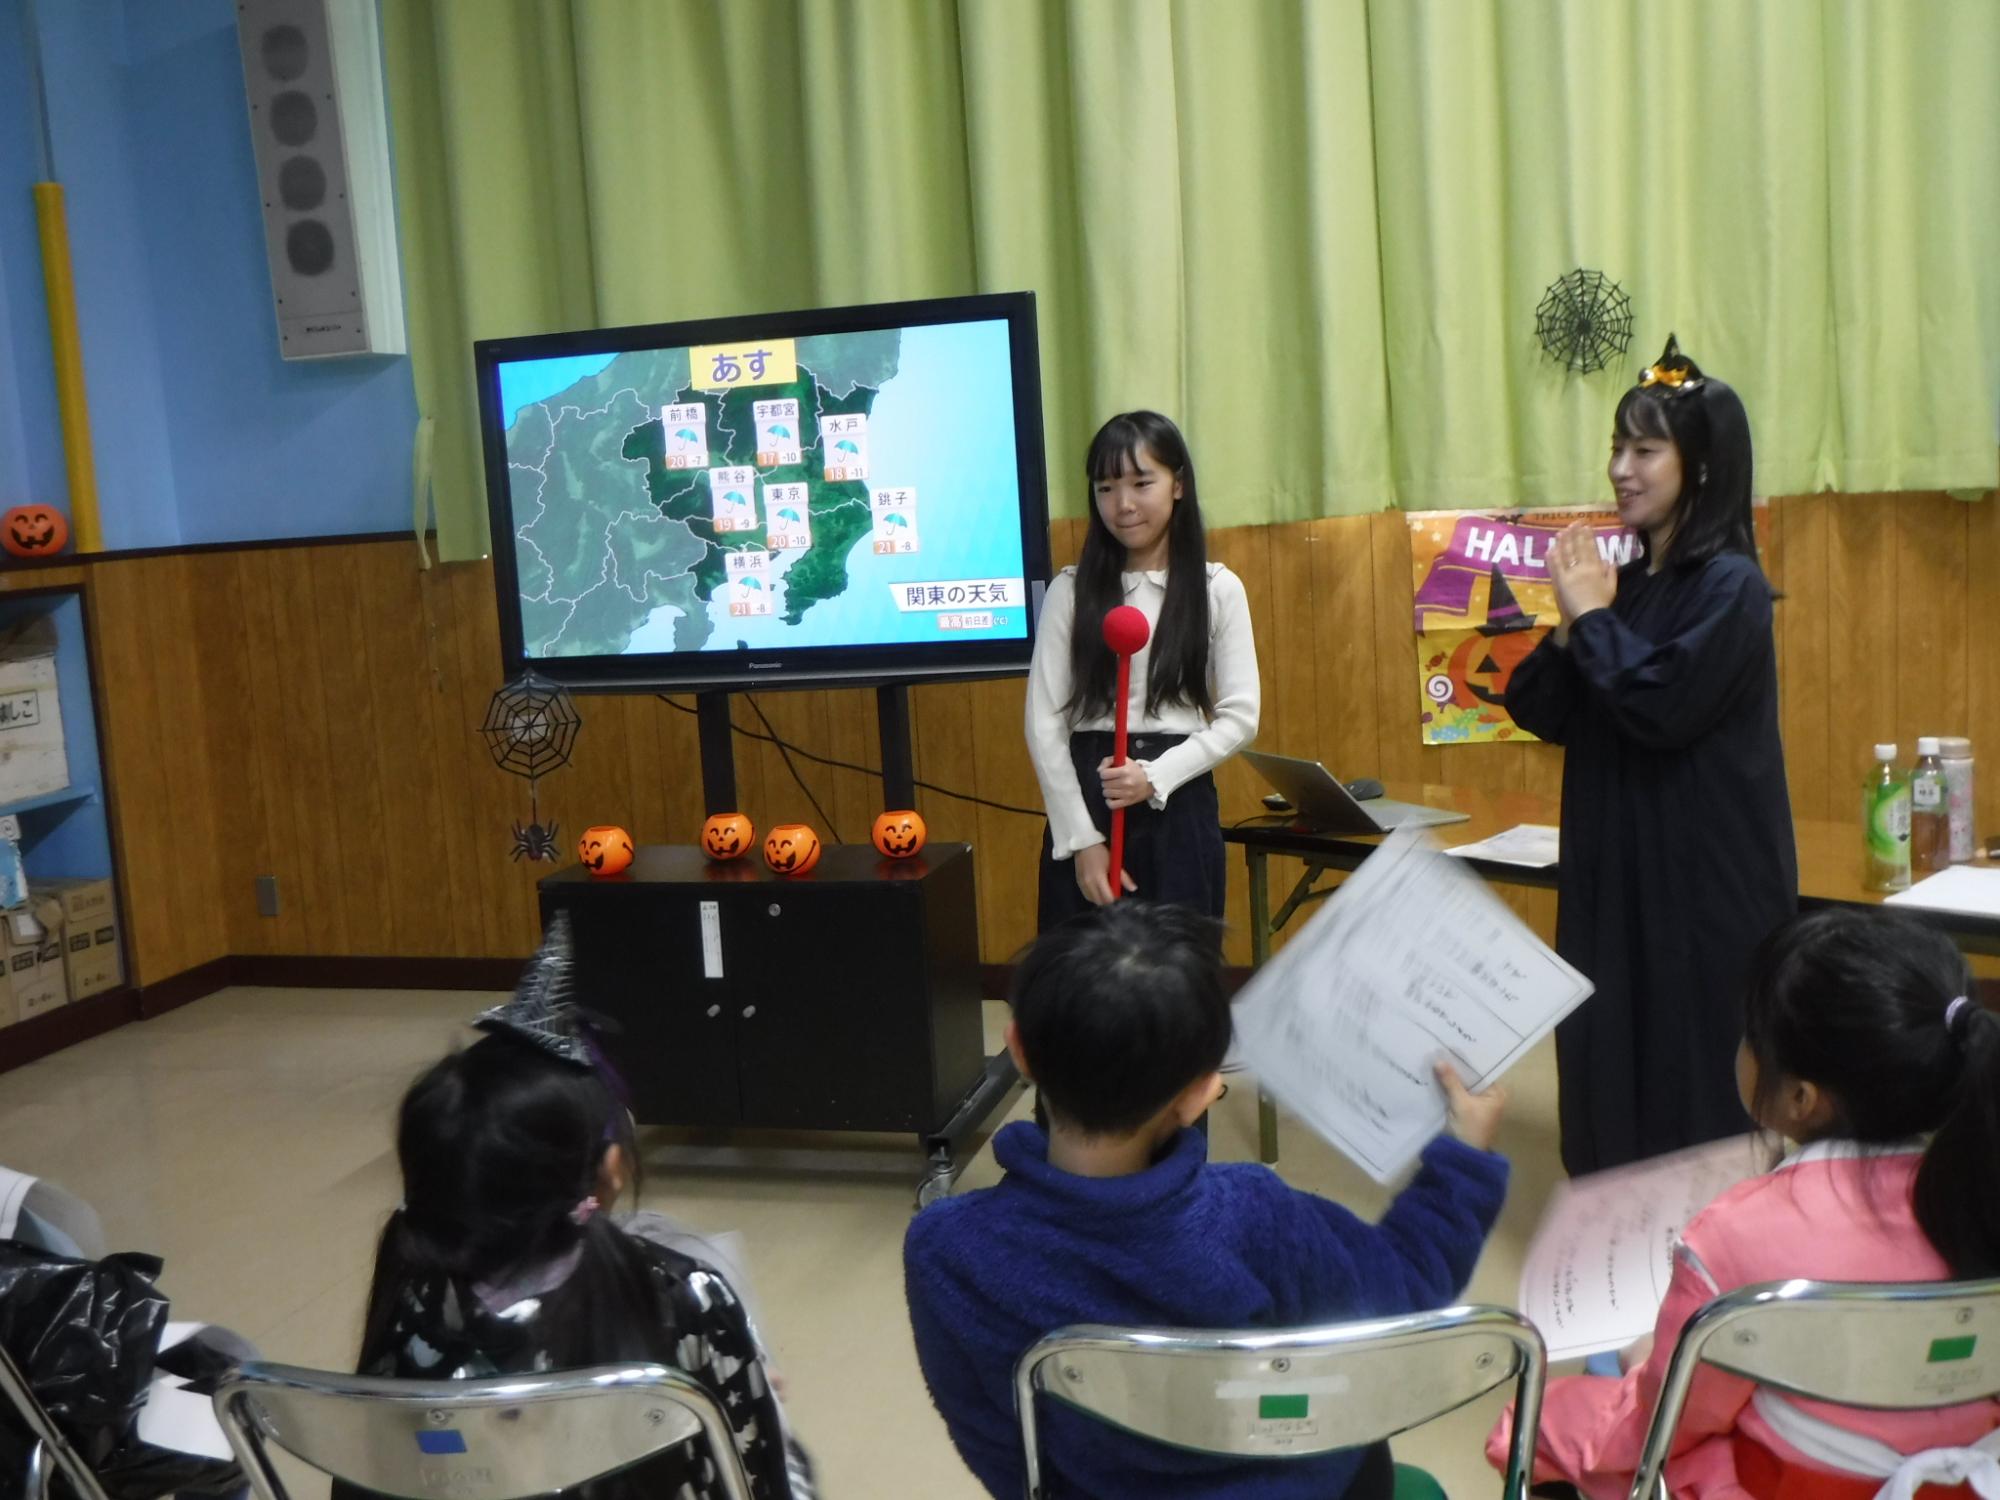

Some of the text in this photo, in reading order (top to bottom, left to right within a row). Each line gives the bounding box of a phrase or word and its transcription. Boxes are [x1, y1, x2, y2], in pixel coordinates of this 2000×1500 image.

[711, 348, 773, 383] あす
[669, 407, 698, 422] 前橋
[756, 403, 796, 418] 宇都宮
[829, 417, 859, 432] 水戸
[670, 456, 686, 468] 20
[762, 453, 797, 465] 17 -10
[717, 469, 746, 484] 熊谷
[831, 468, 864, 480] 18 -11
[771, 487, 801, 501] 東京
[878, 491, 908, 506] 銚子
[719, 518, 732, 530] 19
[771, 535, 806, 548] 20 -10
[879, 541, 893, 554] 21
[733, 554, 763, 570] 横浜
[906, 583, 1009, 606] 関東の天気
[735, 603, 749, 615] 21
